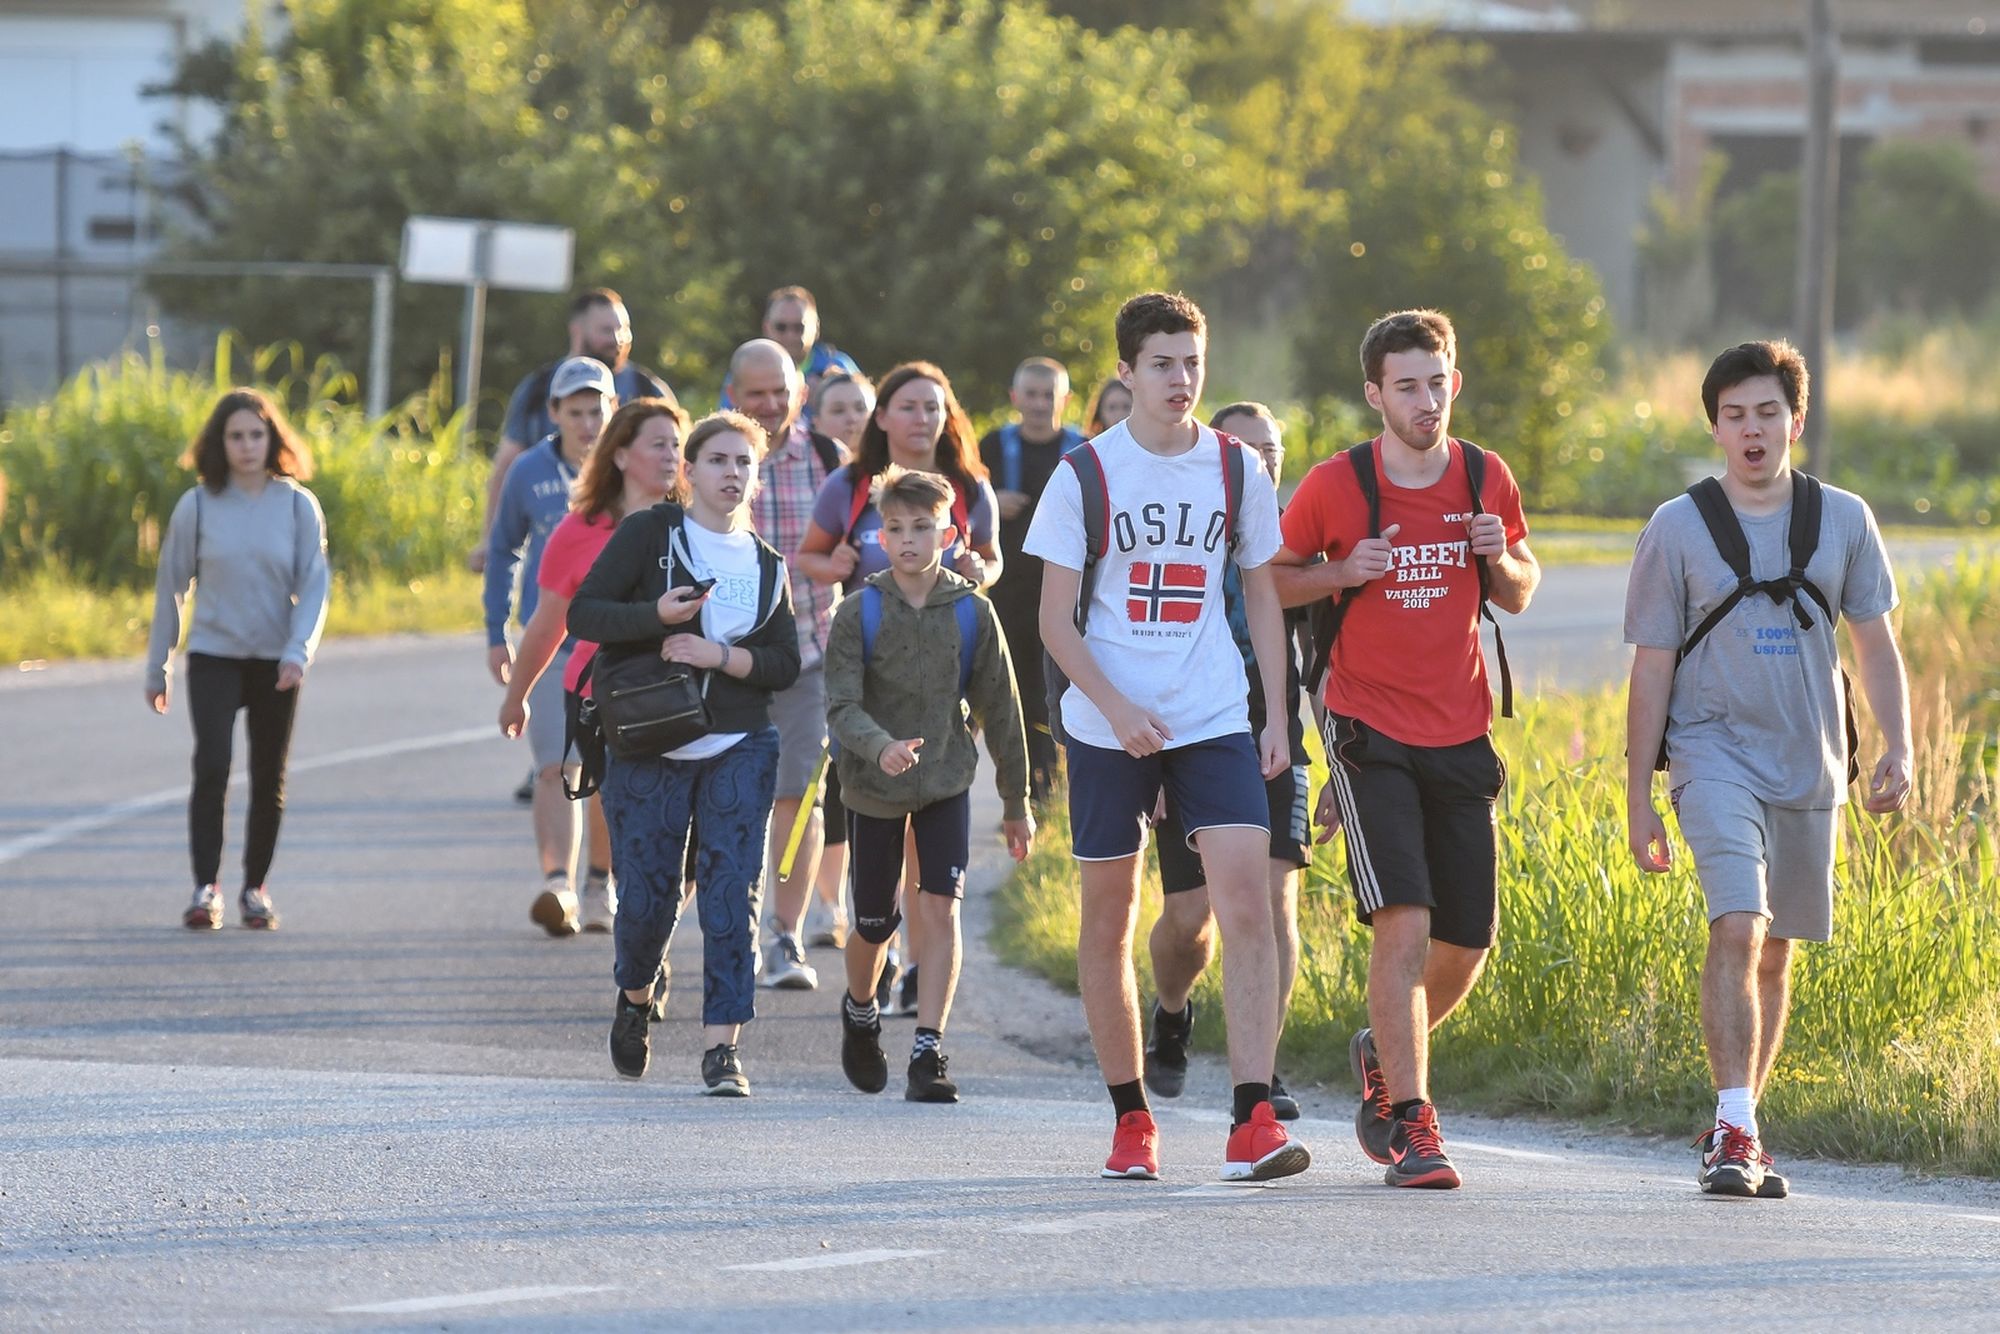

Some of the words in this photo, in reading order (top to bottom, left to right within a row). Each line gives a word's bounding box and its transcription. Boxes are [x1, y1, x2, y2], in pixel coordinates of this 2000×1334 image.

[1113, 501, 1225, 554] OSLO
[1385, 540, 1470, 572] TREET
[1396, 566, 1442, 582] BALL
[1385, 586, 1449, 600] VARAŽDIN
[1402, 598, 1430, 609] 2016
